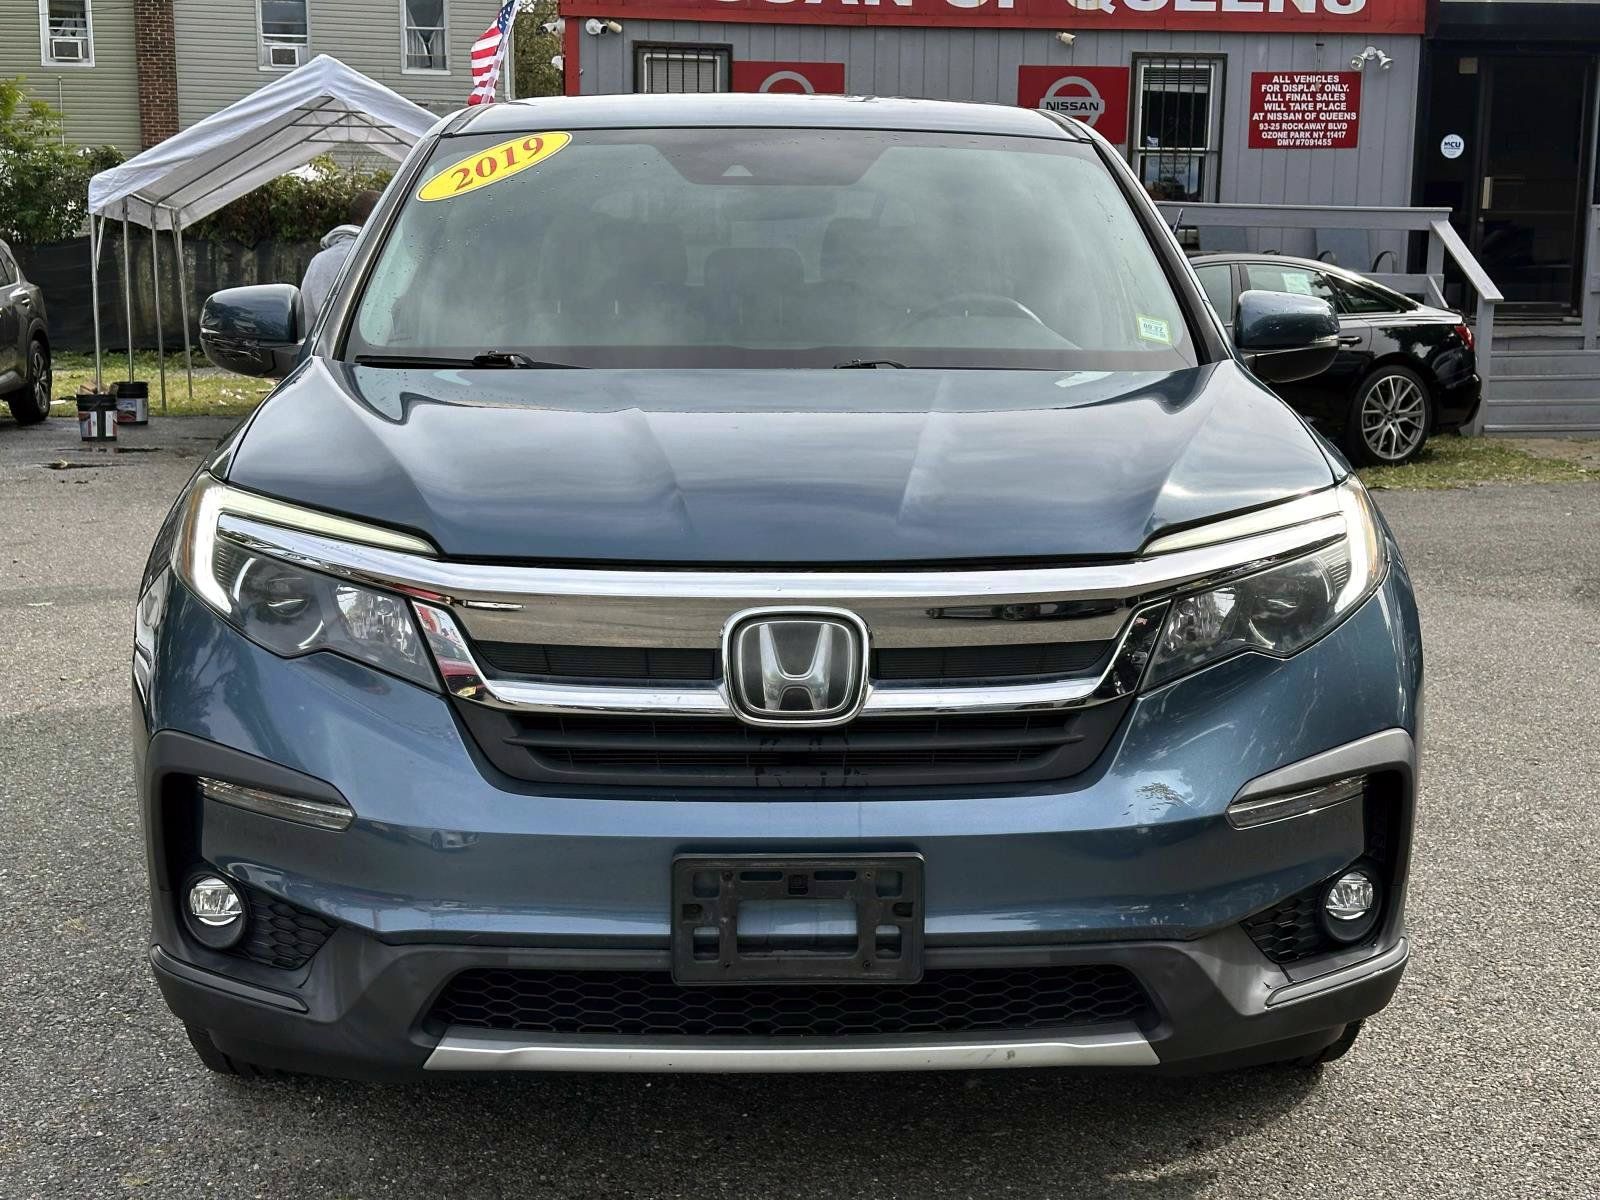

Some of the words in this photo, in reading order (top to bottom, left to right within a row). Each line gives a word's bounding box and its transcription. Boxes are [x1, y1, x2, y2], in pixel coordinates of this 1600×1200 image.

[1272, 75, 1291, 83] ALL
[1294, 75, 1340, 83] VEHICLES
[1261, 84, 1280, 93] FOR
[1324, 84, 1350, 93] ONLY.
[1265, 93, 1284, 102] ALL
[1285, 93, 1314, 102] FINAL
[1316, 93, 1346, 102] SALES
[1046, 101, 1099, 111] NISSAN
[1264, 102, 1287, 111] WILL
[1289, 102, 1314, 111] TAKE
[1316, 102, 1347, 111] PLACE
[1252, 112, 1265, 121] AT
[1267, 112, 1302, 121] NISSAN
[1304, 112, 1318, 121] OF
[1319, 112, 1357, 121] QUEENS
[1259, 122, 1281, 131] 93-25
[1282, 122, 1326, 130] ROCKAWAY
[1328, 122, 1348, 130] BLVD
[1261, 131, 1289, 139] OZONE
[1290, 131, 1312, 139] PARK
[1313, 131, 1325, 139] NY
[1327, 131, 1346, 139] 11417
[1277, 138, 1294, 146] DMV
[450, 137, 545, 192] 2019
